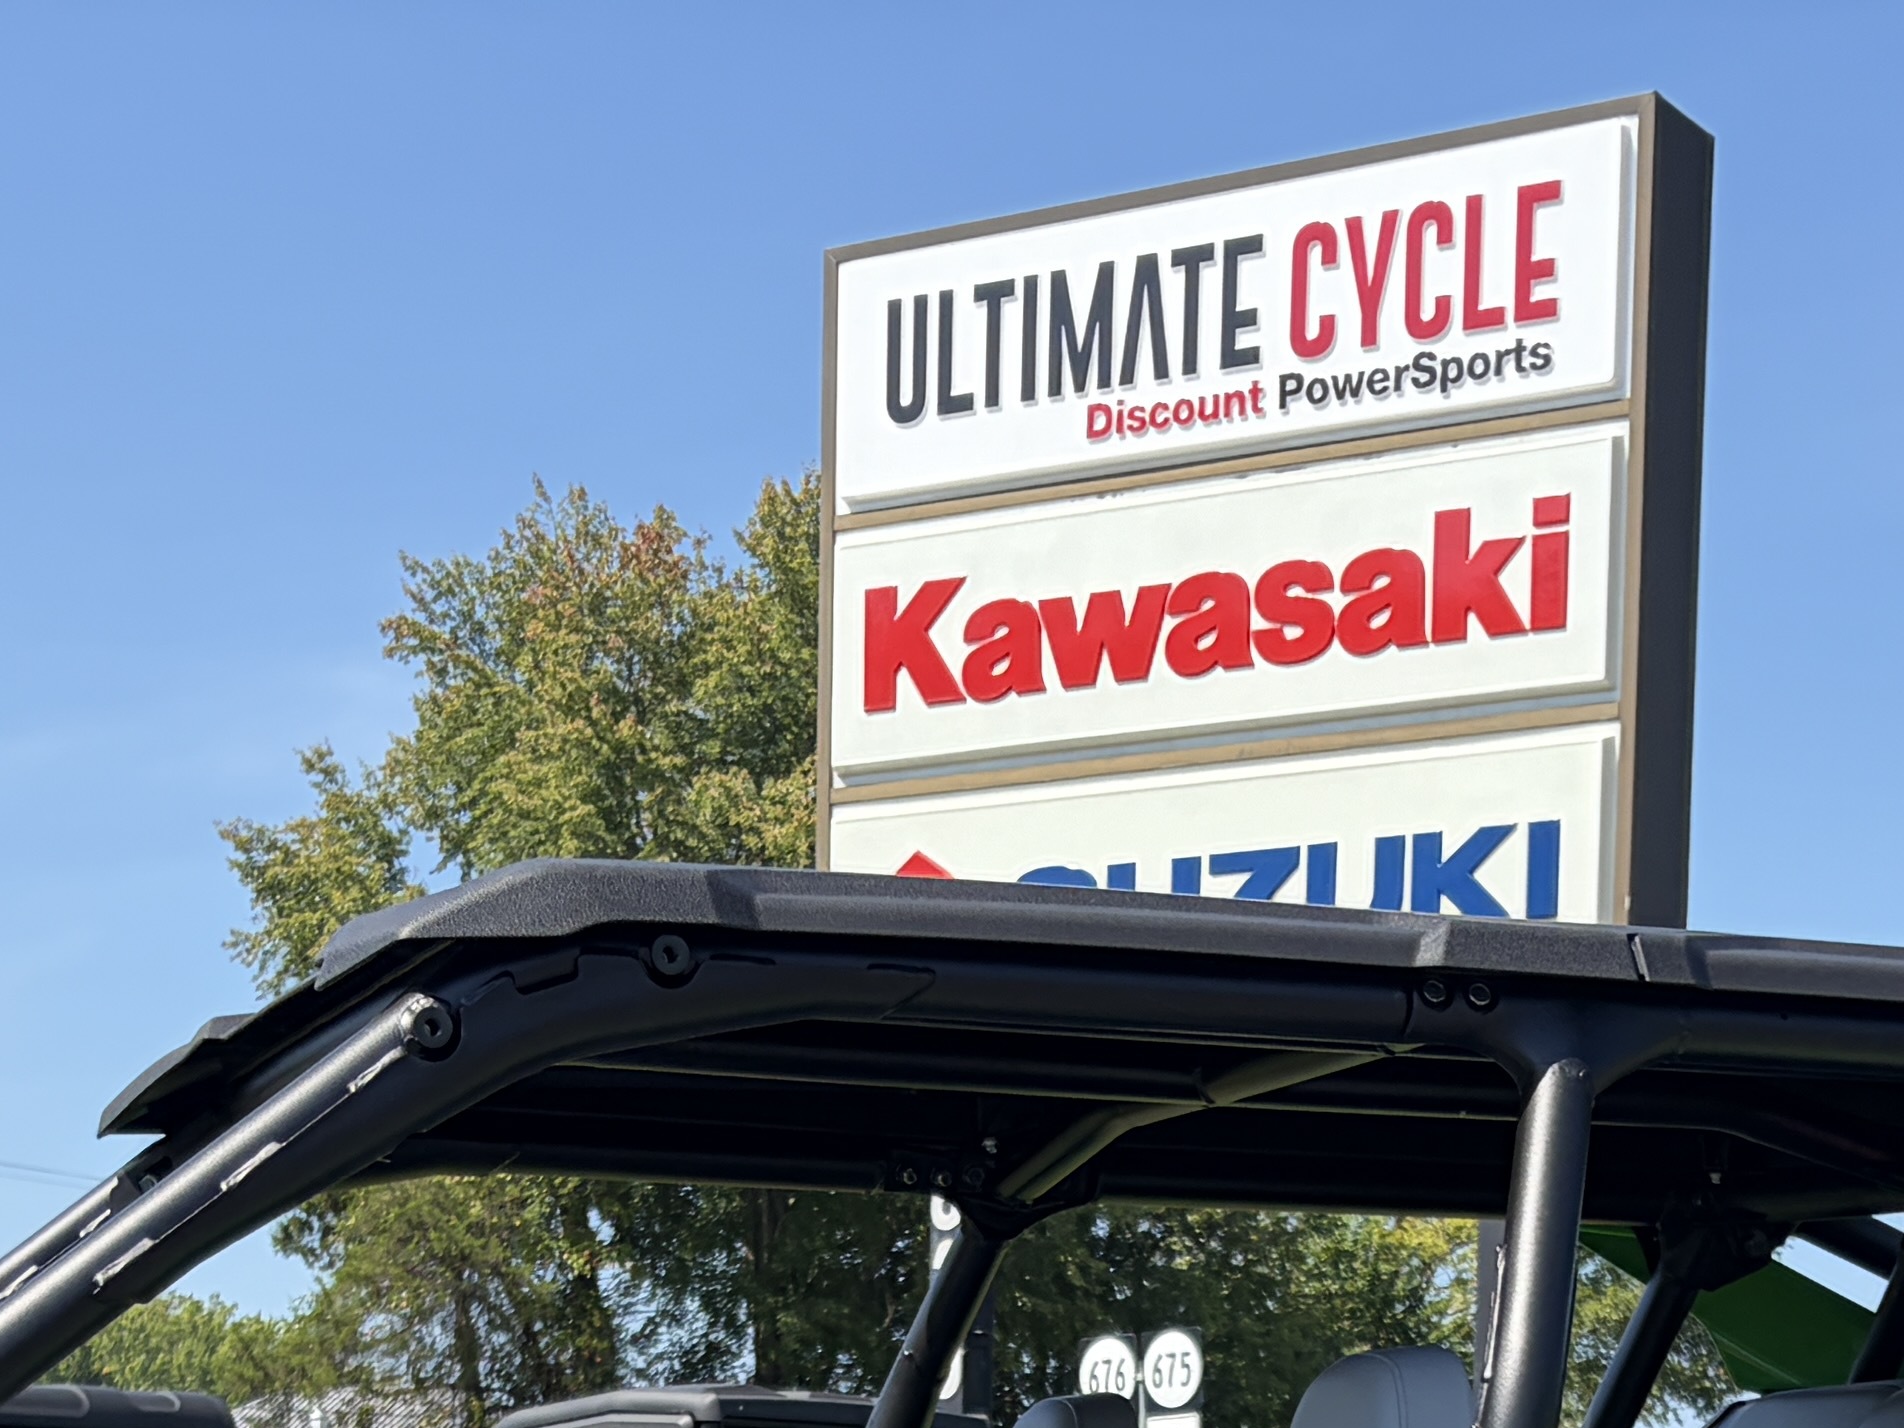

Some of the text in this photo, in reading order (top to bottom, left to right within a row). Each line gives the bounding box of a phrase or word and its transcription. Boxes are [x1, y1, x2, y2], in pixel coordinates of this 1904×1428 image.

[885, 178, 1564, 425] ULTIMATE CYCLE
[1085, 336, 1554, 440] Discount PowerSports
[863, 493, 1572, 713] Kawasaki
[1016, 819, 1562, 920] ZUKI
[1088, 1358, 1126, 1394] 676
[1151, 1351, 1192, 1390] 675
